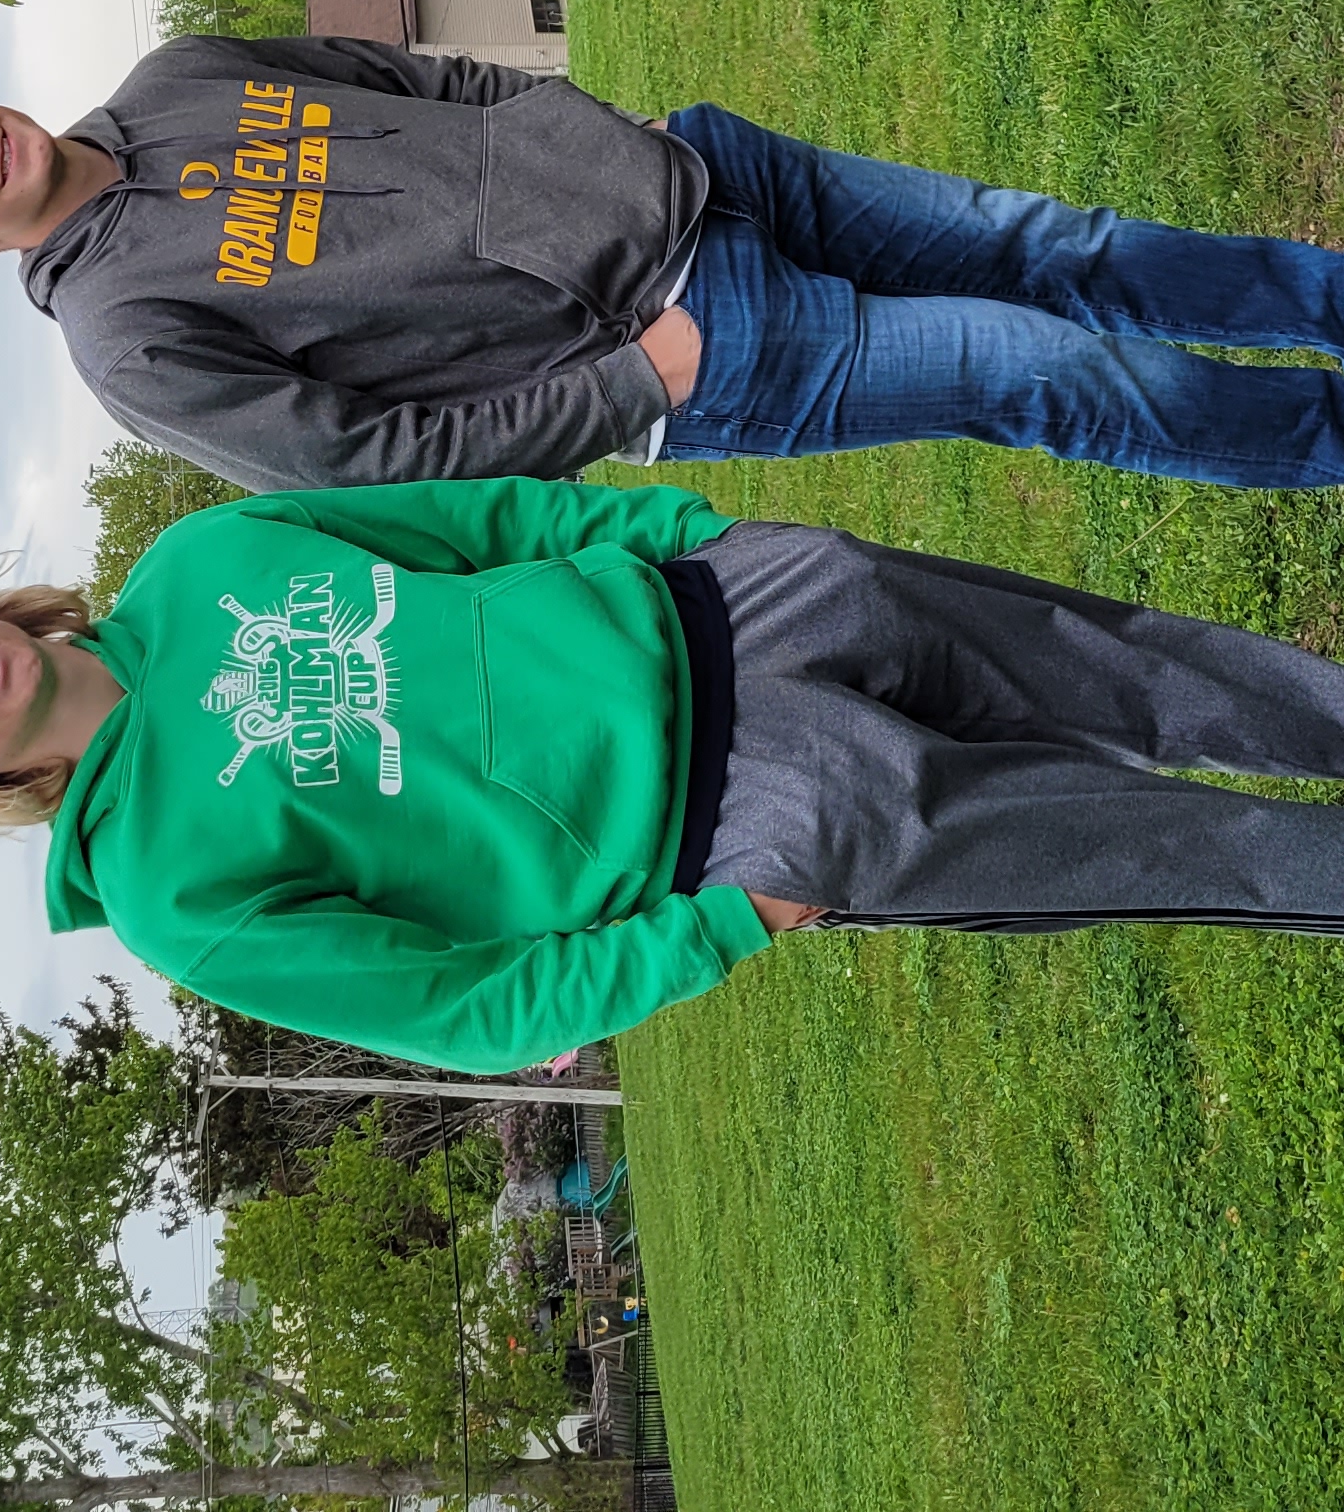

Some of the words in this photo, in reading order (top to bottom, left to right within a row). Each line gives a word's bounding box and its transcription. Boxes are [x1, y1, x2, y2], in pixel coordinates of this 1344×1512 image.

[257, 659, 278, 703] 2016
[287, 572, 340, 787] KOHLMAN
[346, 651, 378, 711] CUP
